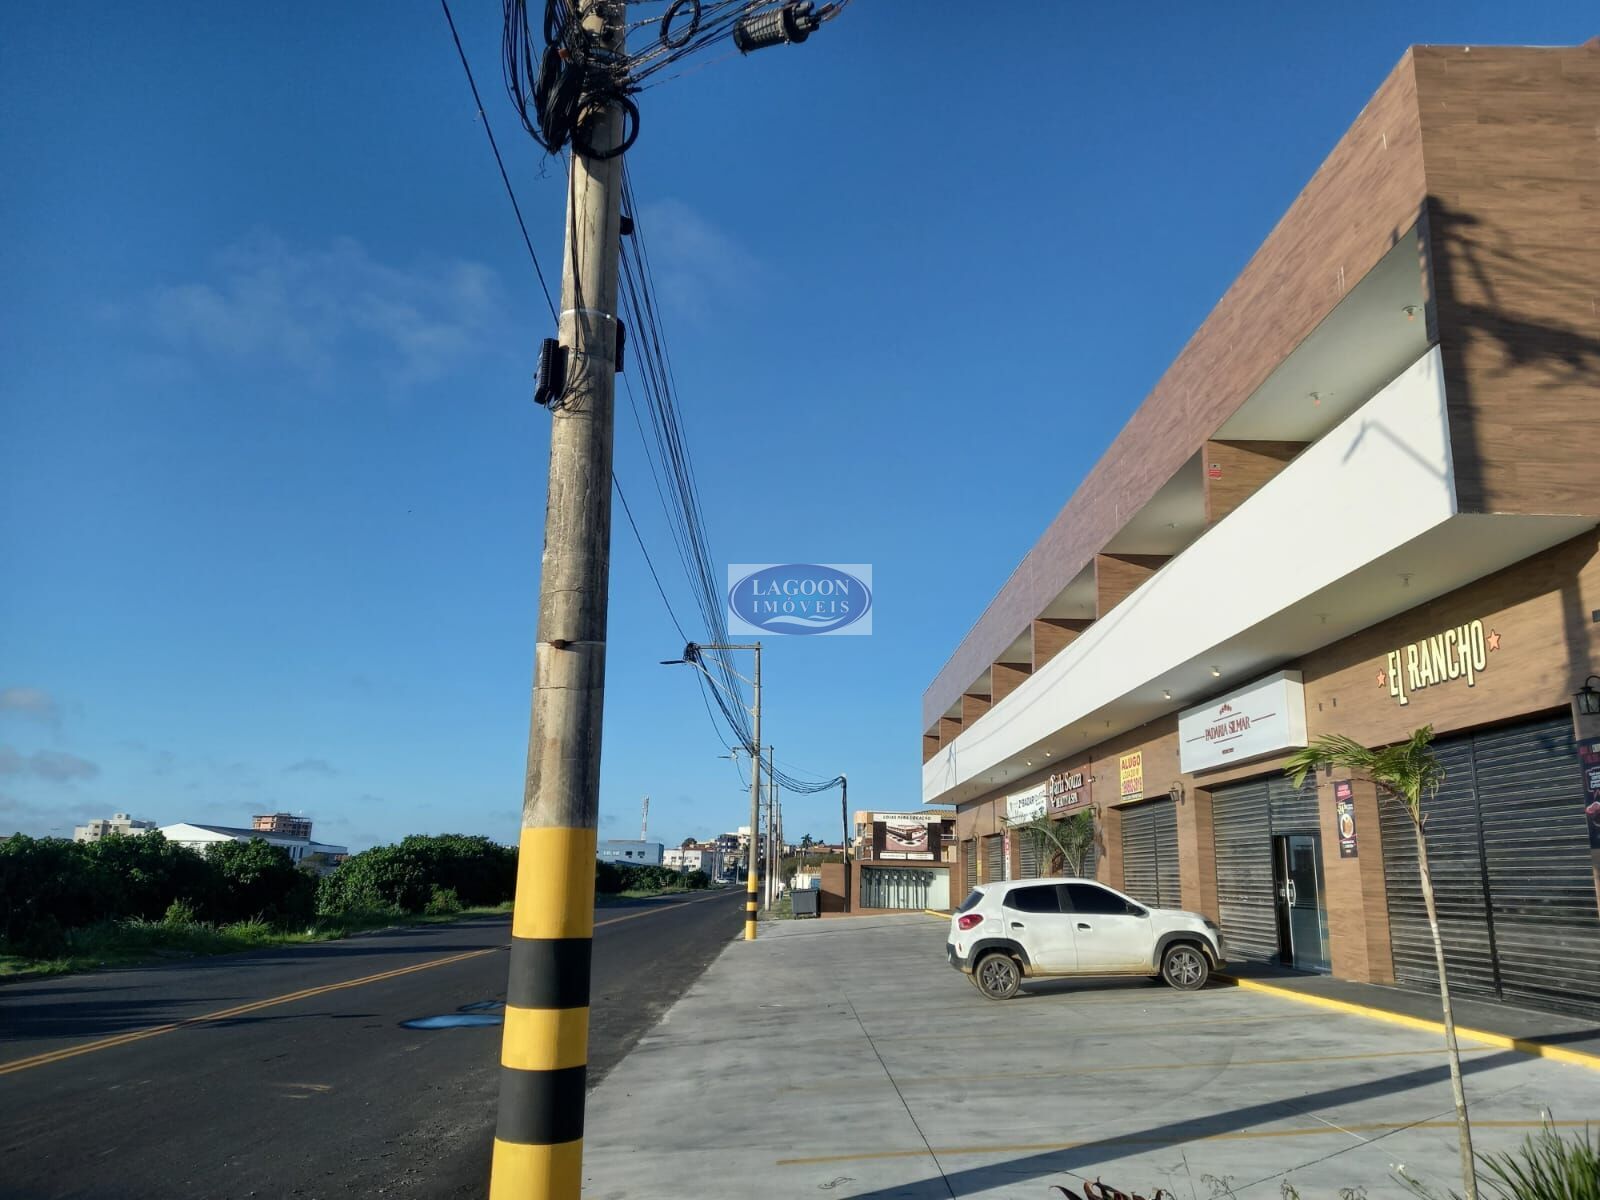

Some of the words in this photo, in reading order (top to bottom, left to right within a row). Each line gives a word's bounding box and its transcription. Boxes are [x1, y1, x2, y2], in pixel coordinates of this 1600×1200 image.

[1387, 649, 1408, 706] EL
[1407, 619, 1487, 690] RANCHO
[1205, 723, 1228, 741] PADARIA
[1228, 716, 1251, 735] SILMAR
[1121, 754, 1141, 769] ALUGO
